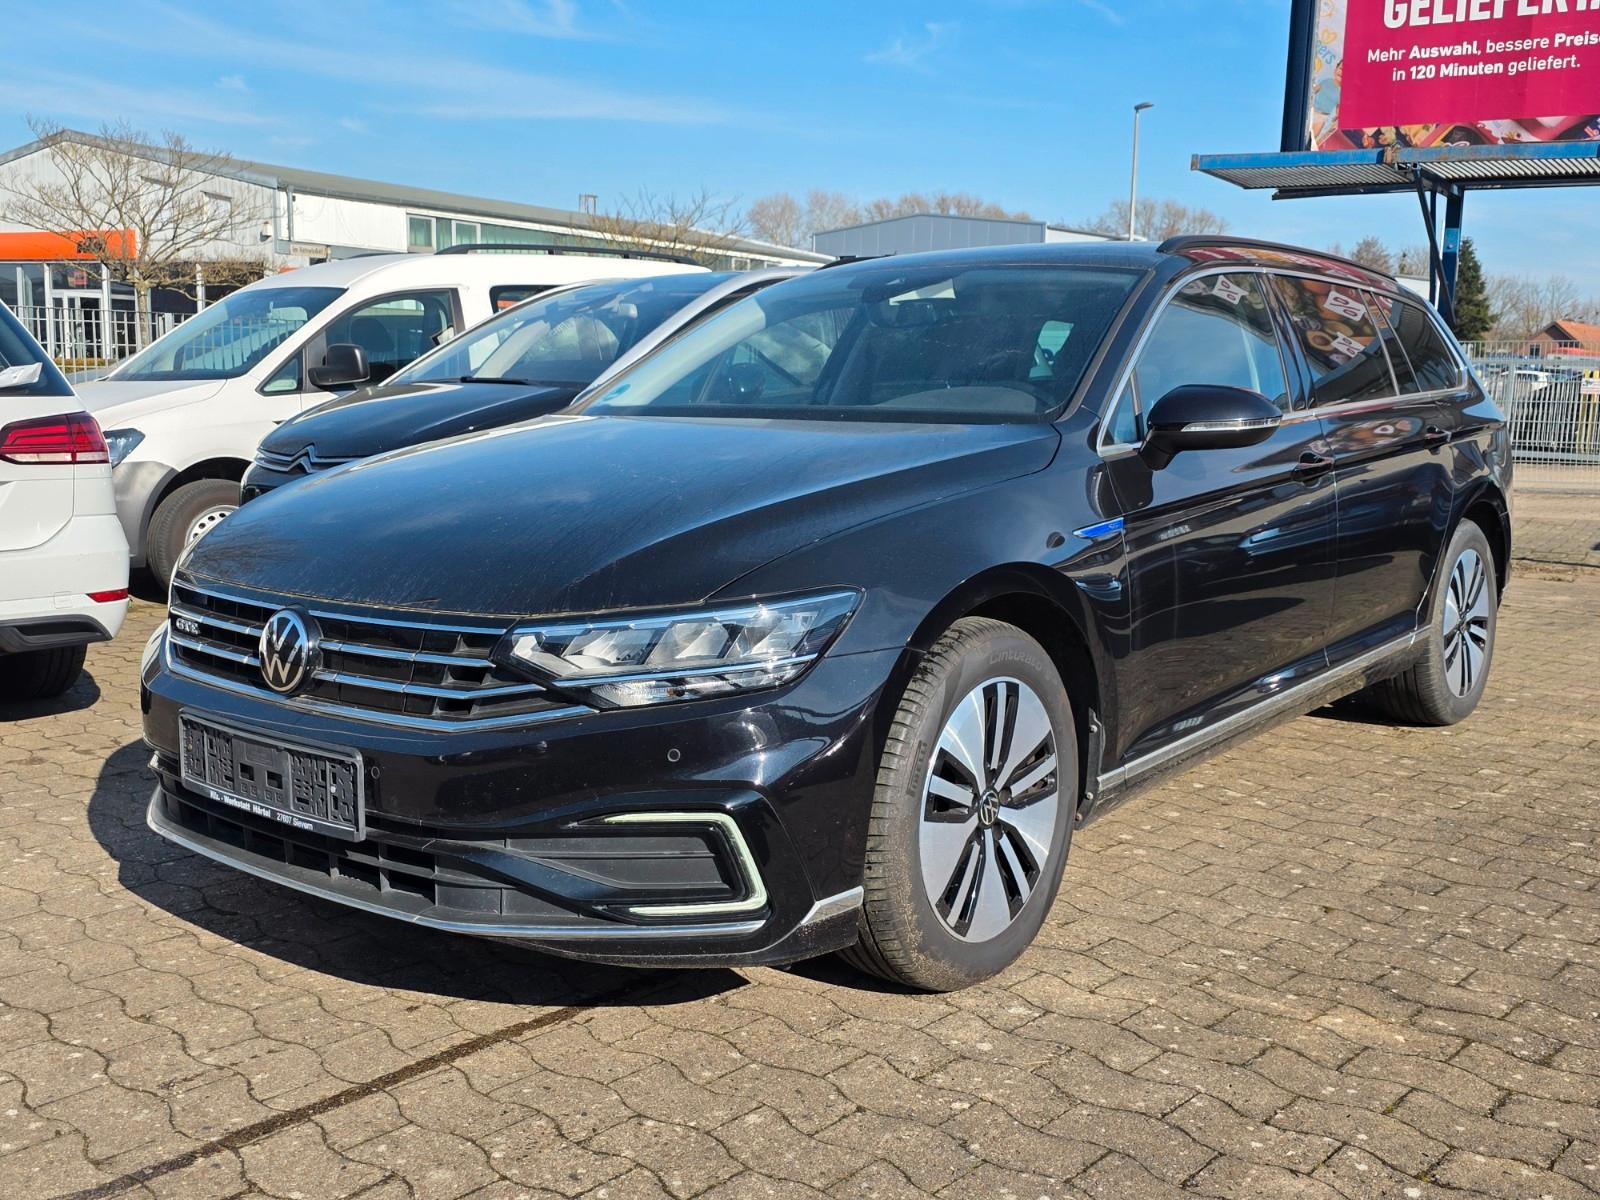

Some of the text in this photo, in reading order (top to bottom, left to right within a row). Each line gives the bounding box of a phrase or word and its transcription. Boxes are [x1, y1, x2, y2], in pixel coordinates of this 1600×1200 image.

[1367, 30, 1600, 63] Mehr Auswahl, bessere Preis
[1392, 54, 1581, 82] in 120 Minuten geliefert.
[175, 617, 199, 635] GTE
